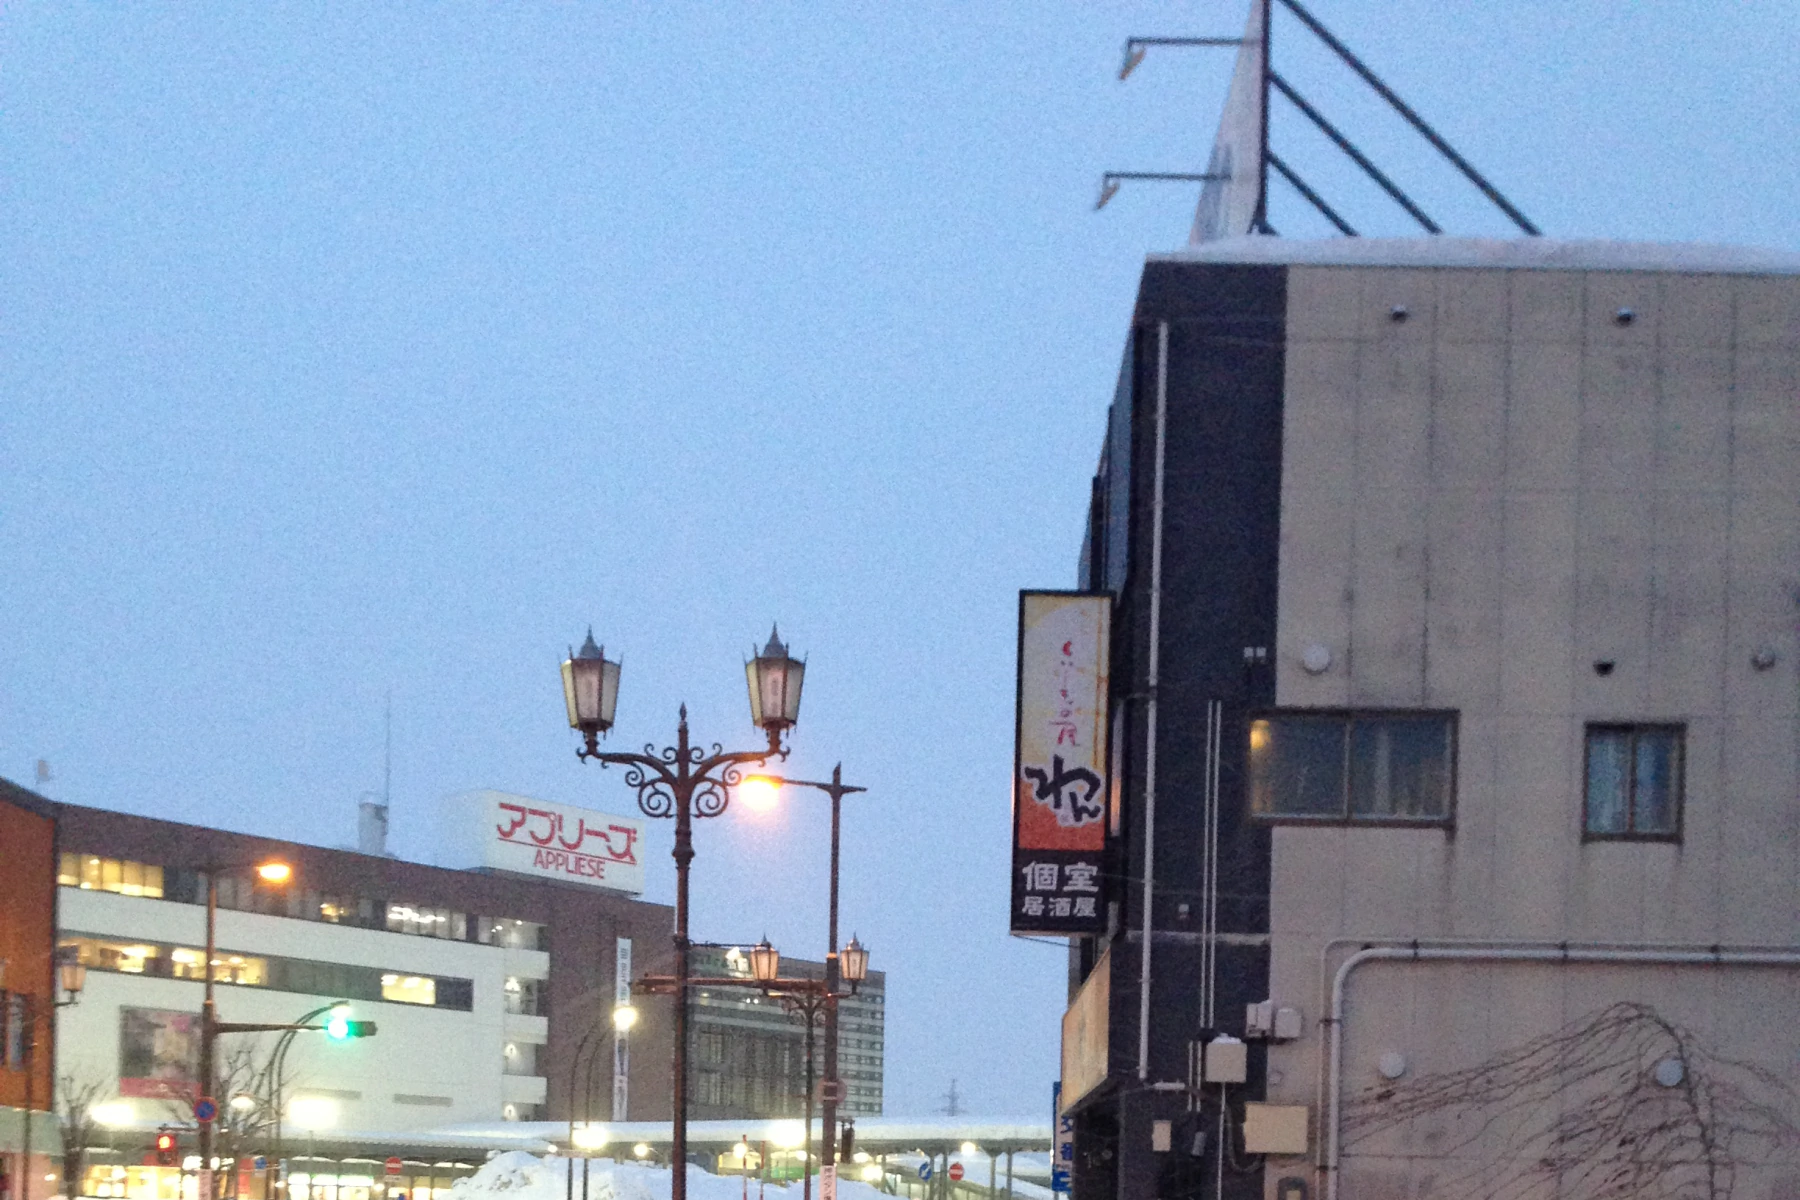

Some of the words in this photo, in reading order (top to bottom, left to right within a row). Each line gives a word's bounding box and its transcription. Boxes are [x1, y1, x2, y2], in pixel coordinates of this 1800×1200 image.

[1025, 754, 1101, 822] わん
[533, 849, 606, 880] APPLIESE
[1022, 860, 1099, 893] 個室
[1022, 895, 1096, 917] 居酒屋
